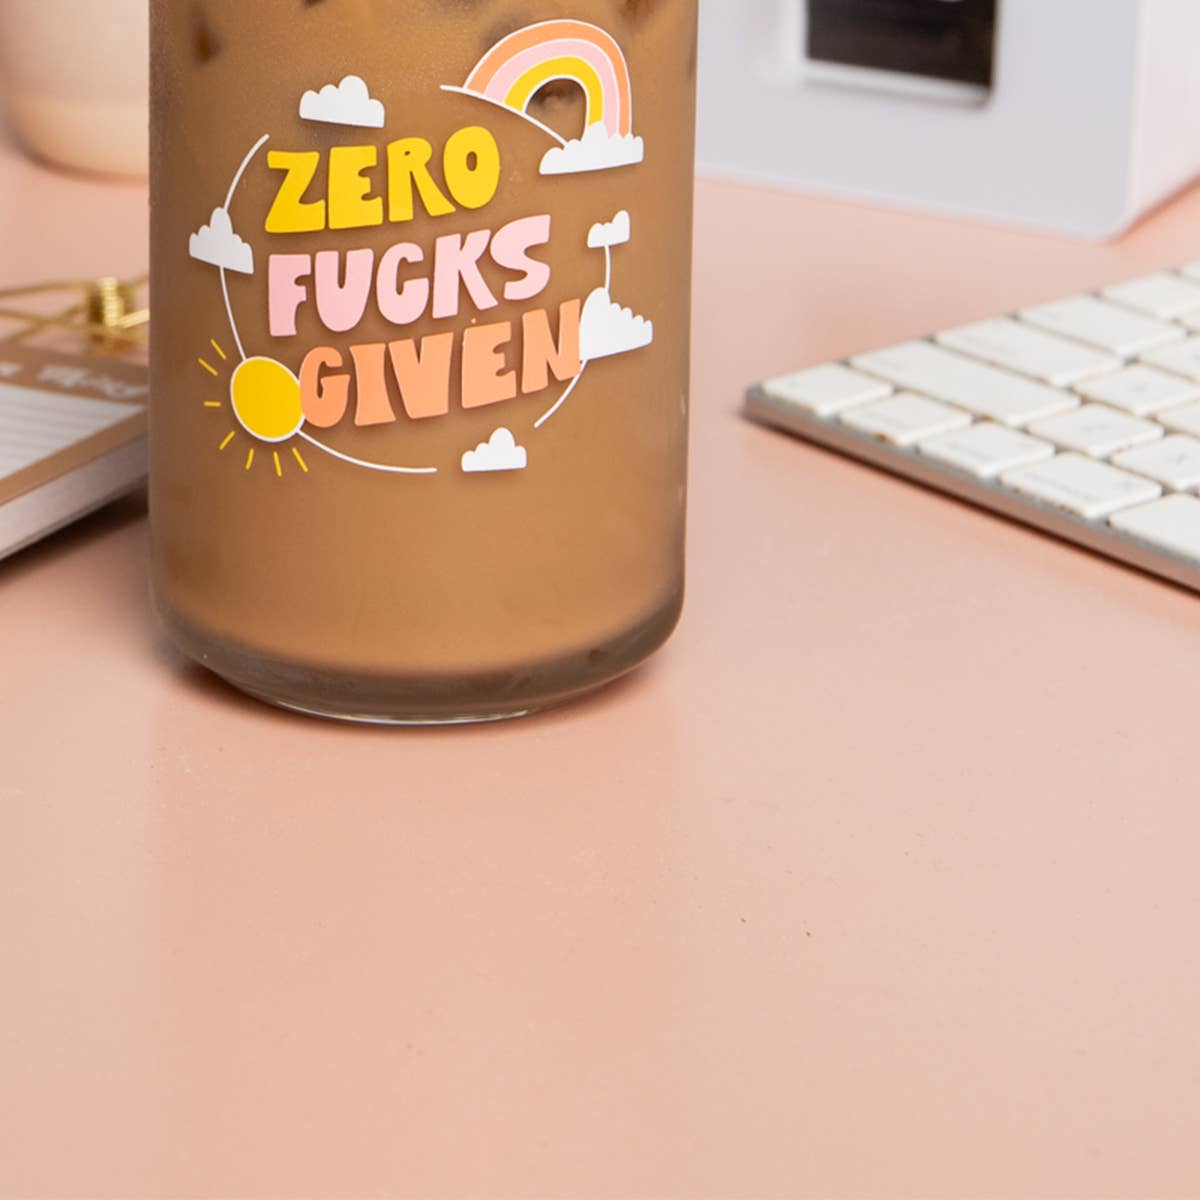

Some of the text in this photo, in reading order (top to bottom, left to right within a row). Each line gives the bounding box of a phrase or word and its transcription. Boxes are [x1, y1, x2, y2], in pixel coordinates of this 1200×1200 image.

[264, 125, 501, 233] ZERO
[267, 214, 552, 337] FUCKS
[299, 298, 583, 428] GIVEN
